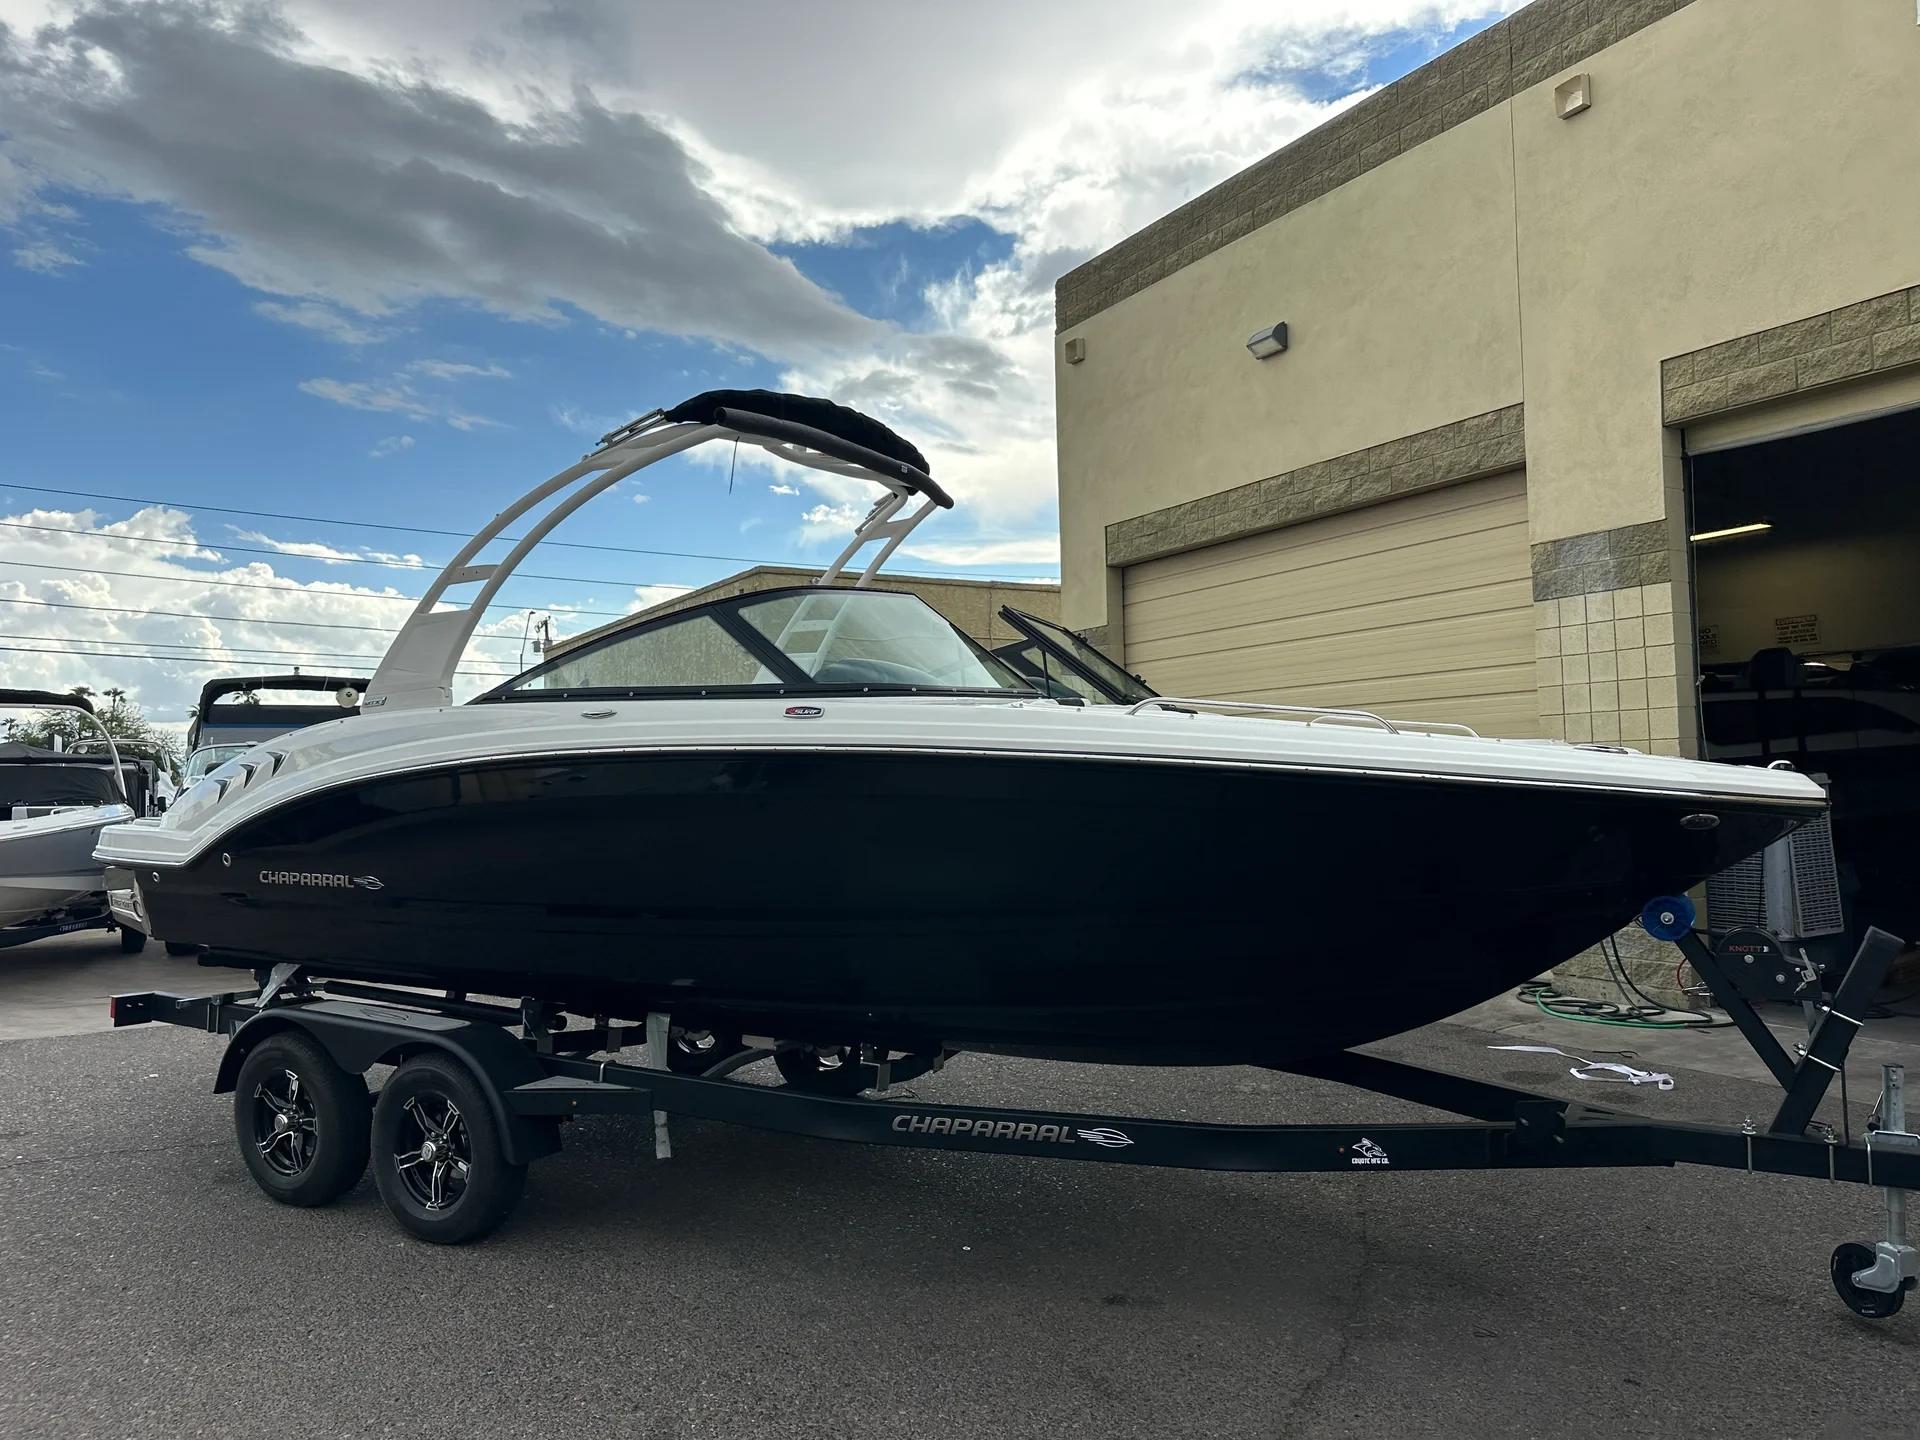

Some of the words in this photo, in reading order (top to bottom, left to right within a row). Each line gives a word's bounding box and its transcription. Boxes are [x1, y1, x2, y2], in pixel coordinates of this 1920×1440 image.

[259, 870, 355, 888] CHAPARRAL
[1729, 945, 1761, 953] KNOTT
[891, 1115, 1076, 1144] CHAPARRAL
